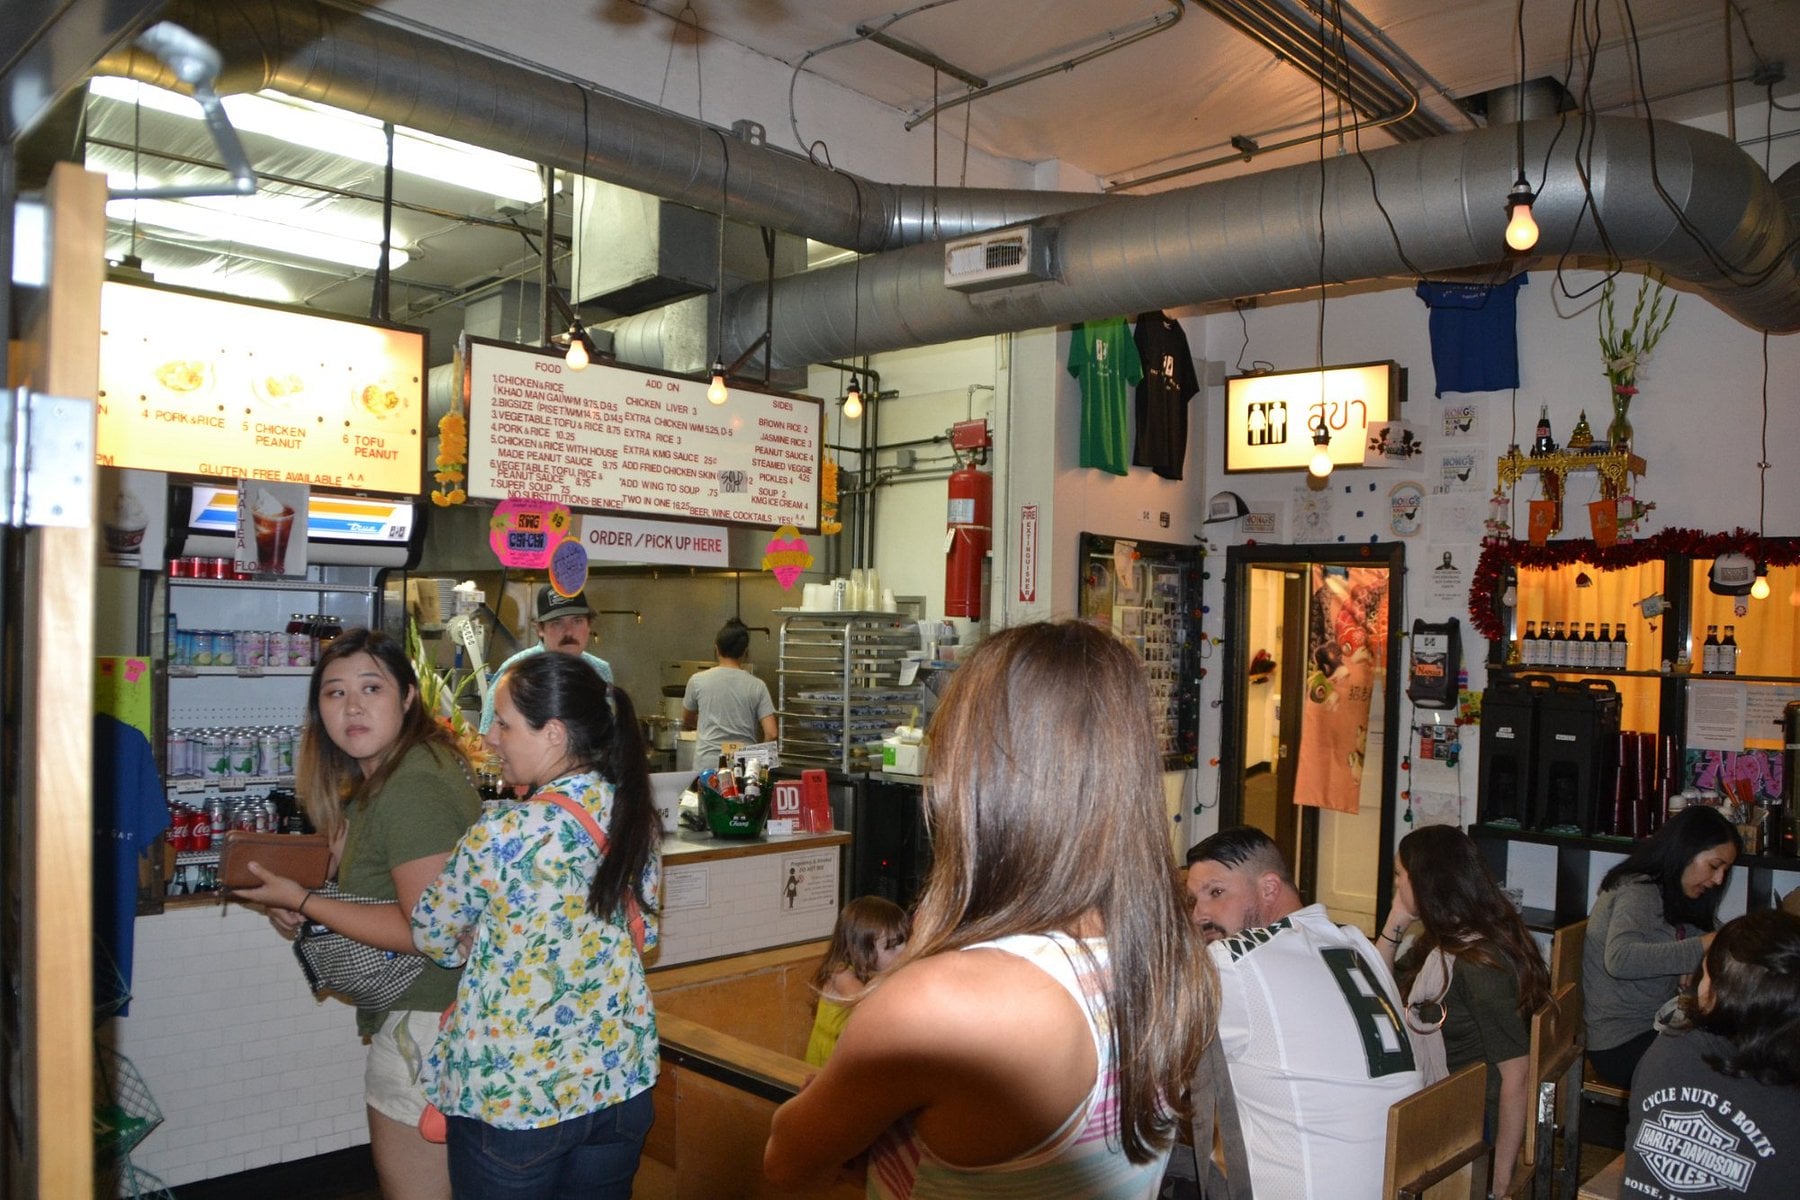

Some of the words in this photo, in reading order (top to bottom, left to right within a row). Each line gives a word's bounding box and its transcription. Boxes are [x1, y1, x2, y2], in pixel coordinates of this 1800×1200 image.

[535, 361, 562, 374] FOOD
[646, 379, 662, 390] ADD
[666, 382, 680, 392] ON
[524, 390, 544, 400] MAN
[626, 396, 662, 410] CHICKEN
[666, 403, 688, 414] LIVER
[692, 408, 698, 416] 3
[772, 400, 794, 412] SIDES
[142, 409, 148, 418] 4
[156, 410, 188, 424] PORK
[198, 416, 226, 428] RICE
[554, 418, 576, 429] TOFU
[584, 421, 604, 432] RICE
[624, 412, 651, 424] EXTRA
[654, 417, 688, 430] CHICKEN
[758, 418, 785, 430] BROWN
[786, 422, 801, 432] RICE
[804, 426, 808, 434] 2
[242, 422, 248, 432] 5
[255, 423, 306, 438] CHICKEN
[343, 434, 350, 444] 6
[355, 435, 385, 448] TOFU
[556, 430, 575, 440] 10.25
[624, 428, 652, 440] EXTRA
[656, 433, 674, 444] RICE
[676, 436, 682, 444] 3
[760, 432, 790, 445] JASMINE
[790, 437, 806, 447] RICE
[807, 440, 812, 448] 3
[256, 435, 302, 450] PEANUT
[354, 446, 398, 460] PEANUT
[566, 444, 588, 454] WITH
[590, 446, 618, 458] HOUSE
[624, 444, 650, 457] EXTRA
[652, 450, 671, 459] KMG
[672, 452, 699, 462] SAUCE
[755, 446, 784, 457] PEANUT
[785, 450, 808, 462] SAUCE
[810, 454, 814, 462] 4
[498, 448, 524, 460] MADE
[526, 450, 562, 463] PEANUT
[564, 455, 592, 466] SAUCE
[602, 460, 618, 470] 9.75
[752, 458, 786, 470] STEAMED
[788, 464, 813, 474] VEGGIE
[199, 463, 248, 478] GLUTEN
[252, 468, 281, 481] FREE
[285, 472, 342, 486] AVAILABLE
[498, 469, 534, 480] PEANUT
[536, 472, 564, 484] SAUCE
[578, 468, 596, 480] RICE
[622, 461, 639, 470] ADD
[640, 462, 662, 473] FRIED
[664, 466, 697, 478] CHICKEN
[698, 470, 716, 480] SKIN
[760, 472, 788, 484] PICKLES
[529, 481, 552, 492] SOUP
[642, 480, 664, 490] WING
[666, 483, 677, 492] TO
[679, 485, 700, 495] SOUP
[758, 488, 778, 497] SOUP
[782, 490, 786, 498] 2
[508, 490, 520, 500] NO
[522, 490, 590, 506] SUBSTITUTIONS
[592, 498, 602, 507] BE
[604, 498, 624, 509] NICE!
[622, 494, 642, 504] TWO
[644, 496, 652, 505] IN
[654, 498, 670, 508] ONE
[751, 496, 768, 506] KMG
[768, 497, 778, 506] ICE
[780, 500, 803, 510] CREAM
[733, 511, 772, 522] COCKTAILS
[778, 516, 793, 525] YES!
[1022, 510, 1036, 520] FIRE
[590, 530, 632, 546] ORDER
[676, 536, 692, 551] UP
[693, 538, 722, 552] HERE
[1642, 1087, 1676, 1112] CYCLE
[1681, 1086, 1718, 1108] NUTS
[1718, 1100, 1732, 1116] &
[1731, 1110, 1776, 1158] BOLTS
[1668, 1118, 1725, 1148] MOTOR
[1641, 1127, 1744, 1181] HARLEY-DAVIDSON
[1654, 1154, 1709, 1186] CYCLES
